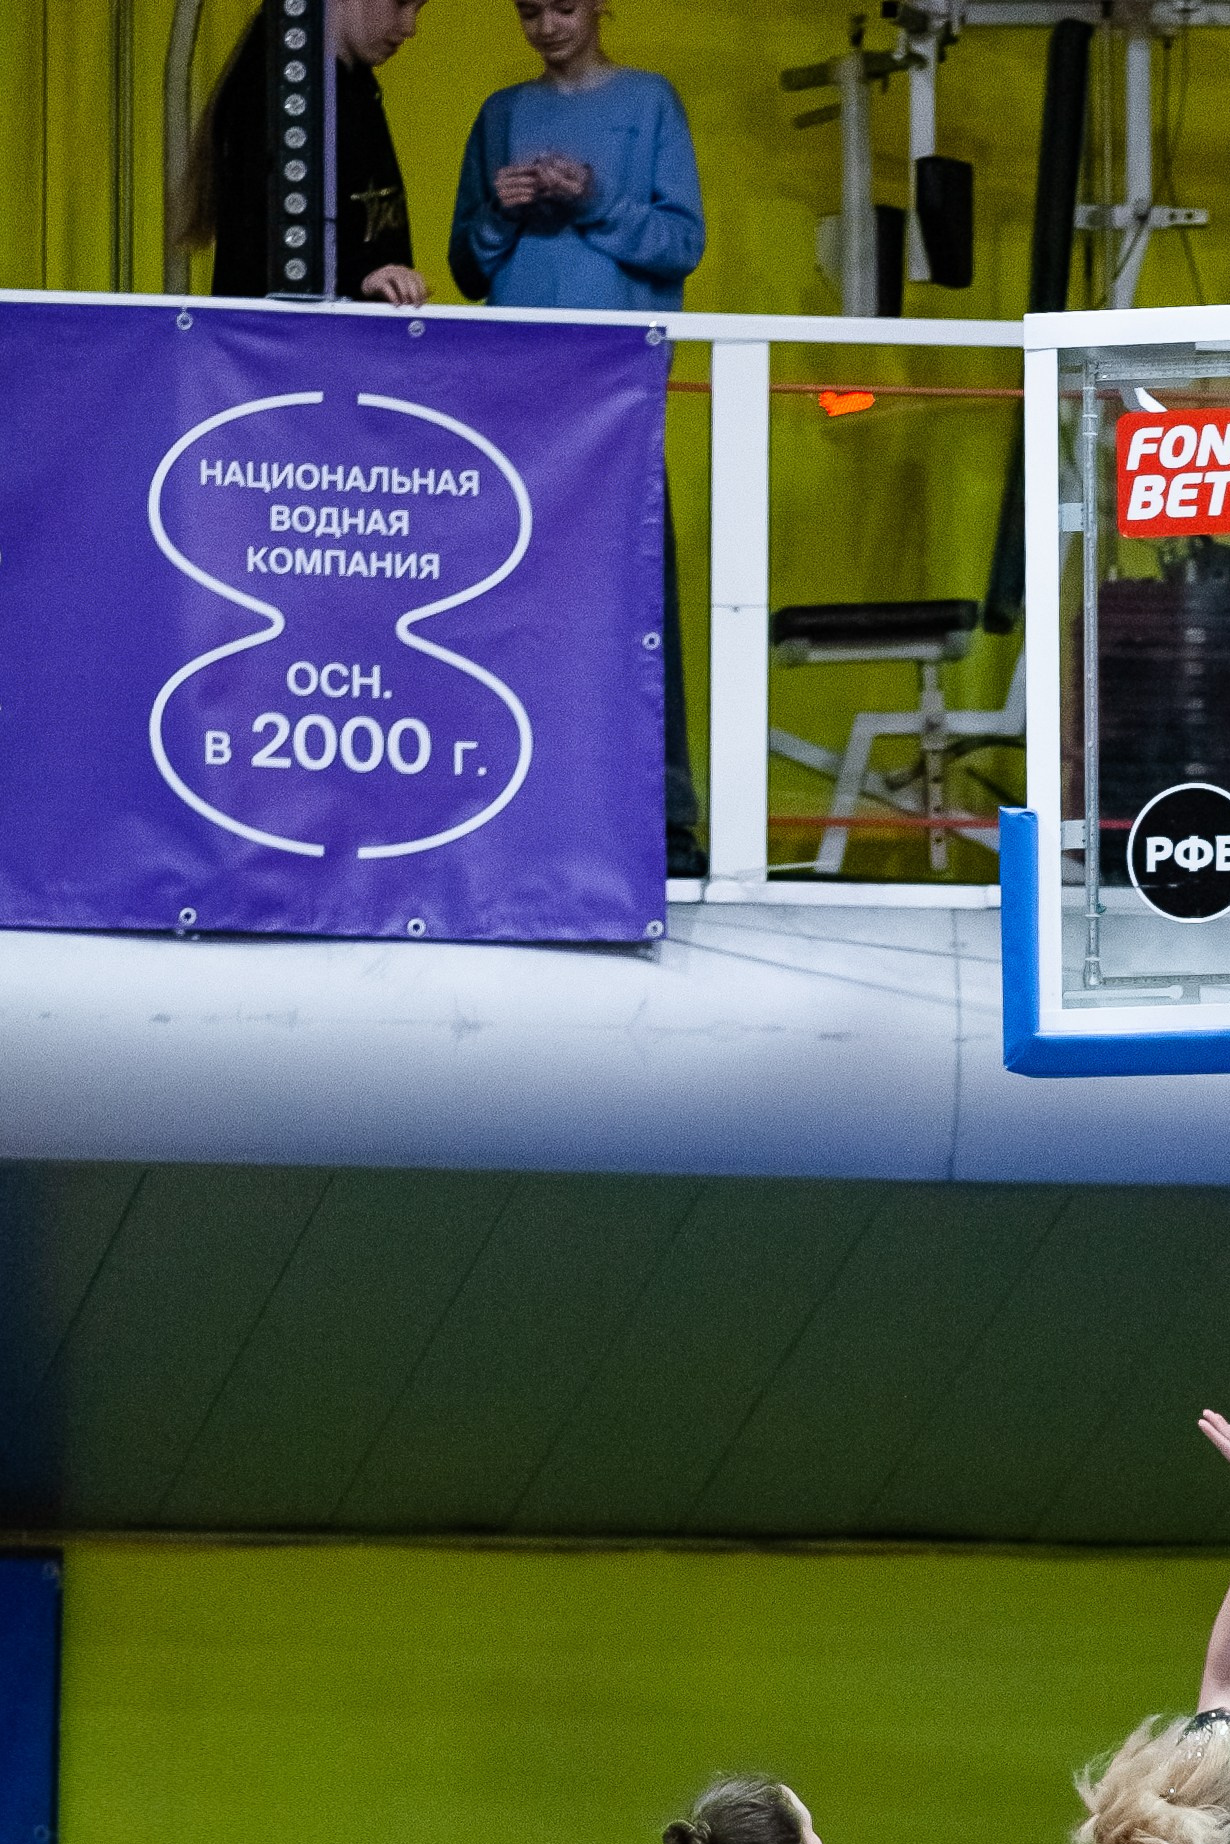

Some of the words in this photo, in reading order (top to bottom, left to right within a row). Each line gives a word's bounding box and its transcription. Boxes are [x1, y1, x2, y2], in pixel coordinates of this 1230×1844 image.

[200, 459, 480, 496] НАЦИОНАЛЬНАЯ
[270, 504, 410, 538] ВОДНАЯ
[246, 546, 440, 579] КОМПАНИЯ
[286, 660, 392, 699] ОСН.
[251, 711, 432, 775] 2000
